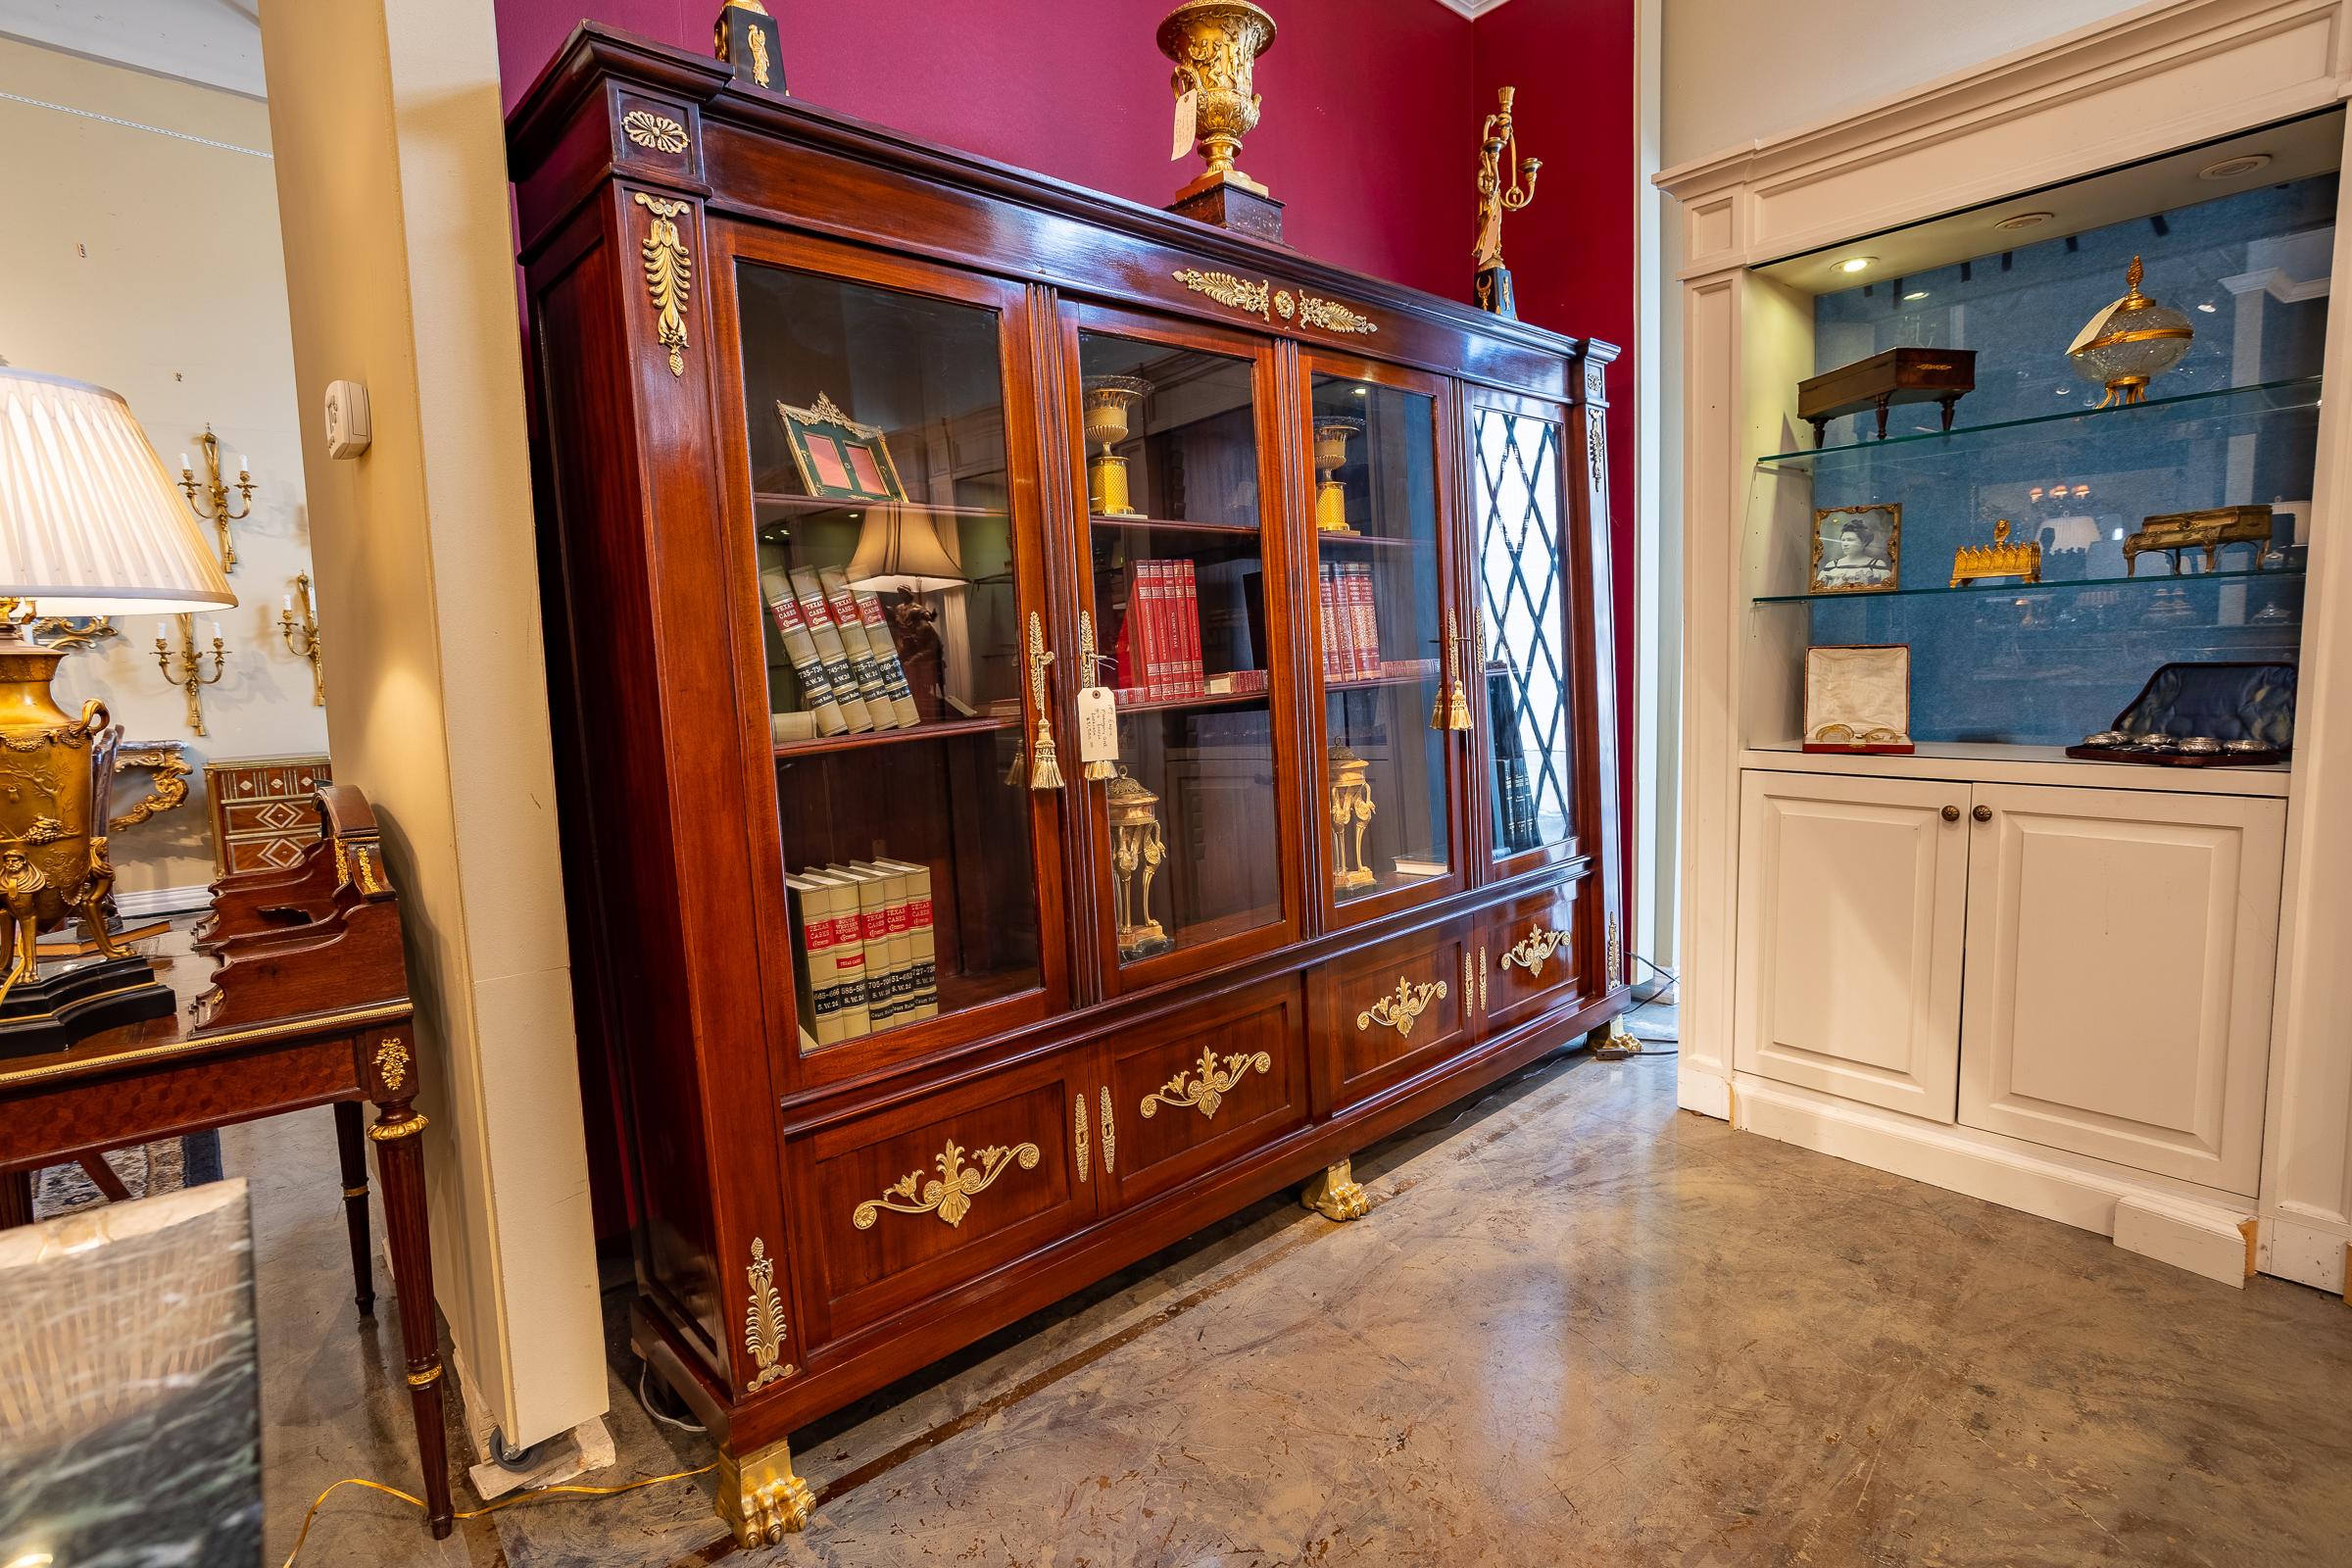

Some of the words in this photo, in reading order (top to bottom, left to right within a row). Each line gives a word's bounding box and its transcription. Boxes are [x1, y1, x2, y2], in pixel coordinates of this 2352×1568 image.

[776, 602, 794, 612] TEXAS
[806, 600, 823, 610] TEXAS
[779, 610, 796, 619] CASES
[809, 608, 825, 616] CASES
[887, 907, 906, 916] TEXAS
[810, 930, 830, 940] CASES
